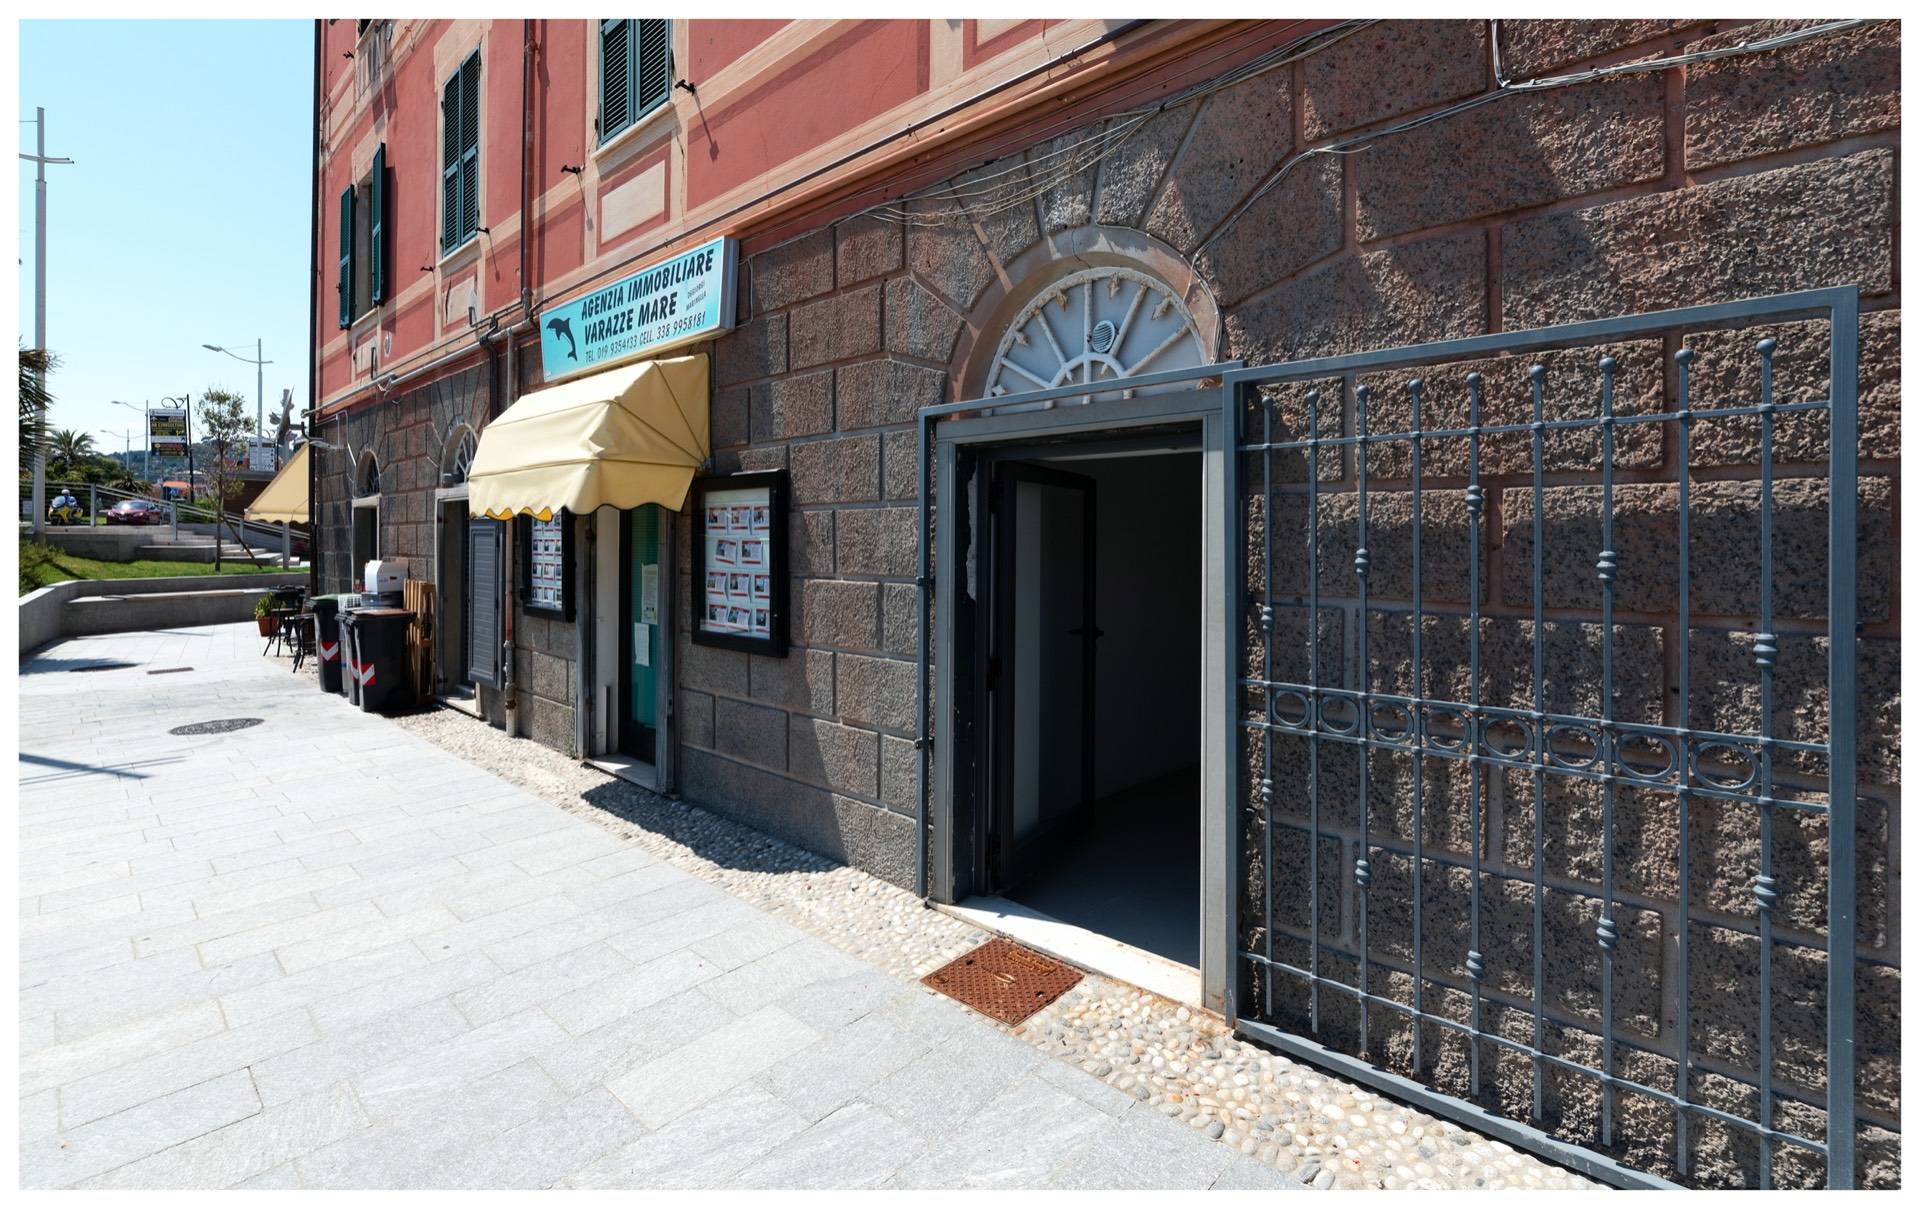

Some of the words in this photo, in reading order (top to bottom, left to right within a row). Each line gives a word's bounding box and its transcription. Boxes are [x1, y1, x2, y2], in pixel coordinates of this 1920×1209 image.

[581, 286, 624, 320] AGENZIA
[627, 248, 714, 303] IMMOBILIARE
[584, 308, 634, 345] VARAZZE
[638, 291, 677, 327] MARE
[597, 345, 608, 360] 019
[610, 335, 637, 354] 9354133
[656, 323, 670, 340] 338
[673, 311, 706, 337] 9958181
